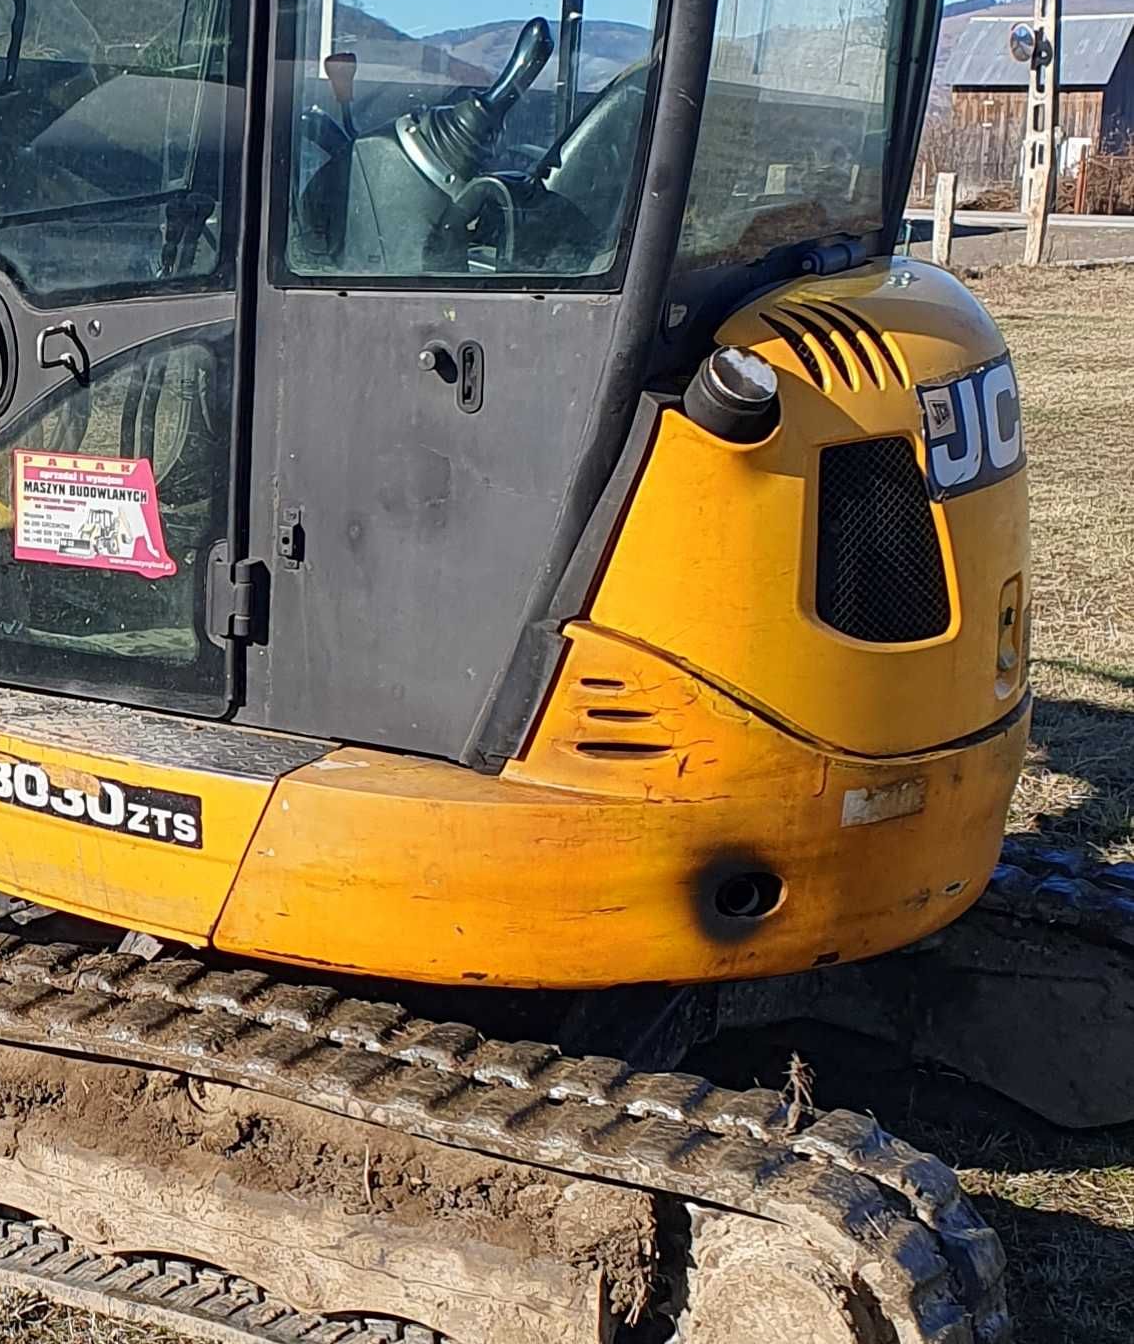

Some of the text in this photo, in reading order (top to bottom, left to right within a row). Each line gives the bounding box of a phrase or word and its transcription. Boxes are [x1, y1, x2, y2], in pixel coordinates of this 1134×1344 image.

[23, 455, 131, 473] PALAK
[23, 480, 66, 496] MASZYN
[69, 485, 147, 503] BUDOWLANYCH
